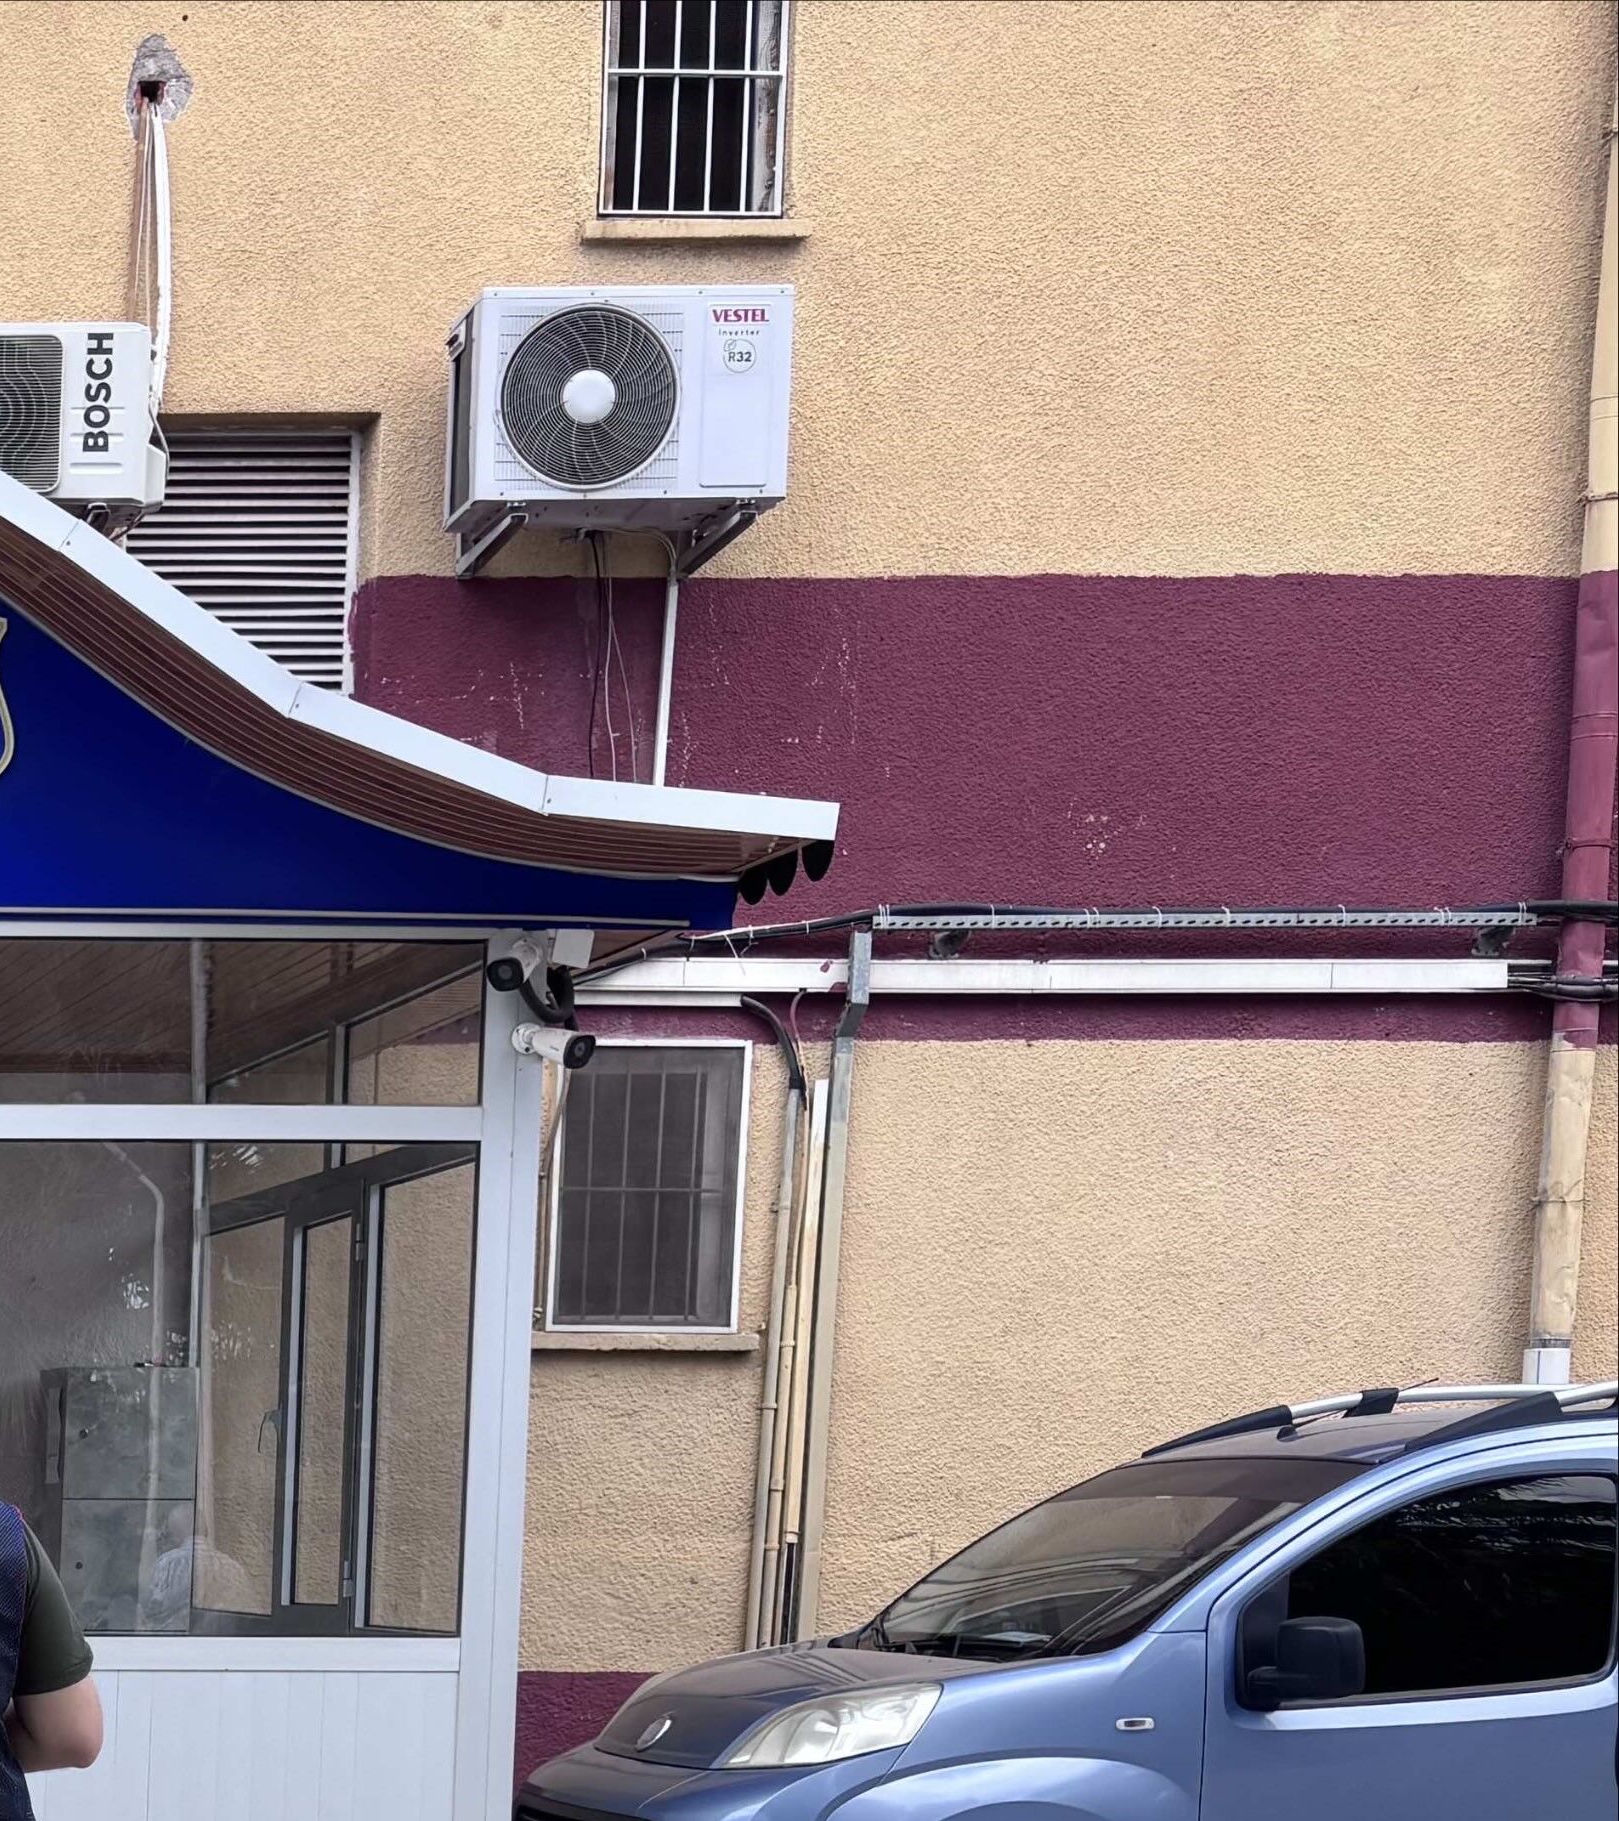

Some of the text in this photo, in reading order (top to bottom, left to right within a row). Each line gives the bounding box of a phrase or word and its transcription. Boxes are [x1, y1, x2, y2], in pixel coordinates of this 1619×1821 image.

[712, 308, 770, 323] VESTEL
[718, 328, 760, 336] Inverter
[728, 351, 752, 362] R32
[82, 332, 114, 453] BOSCH
